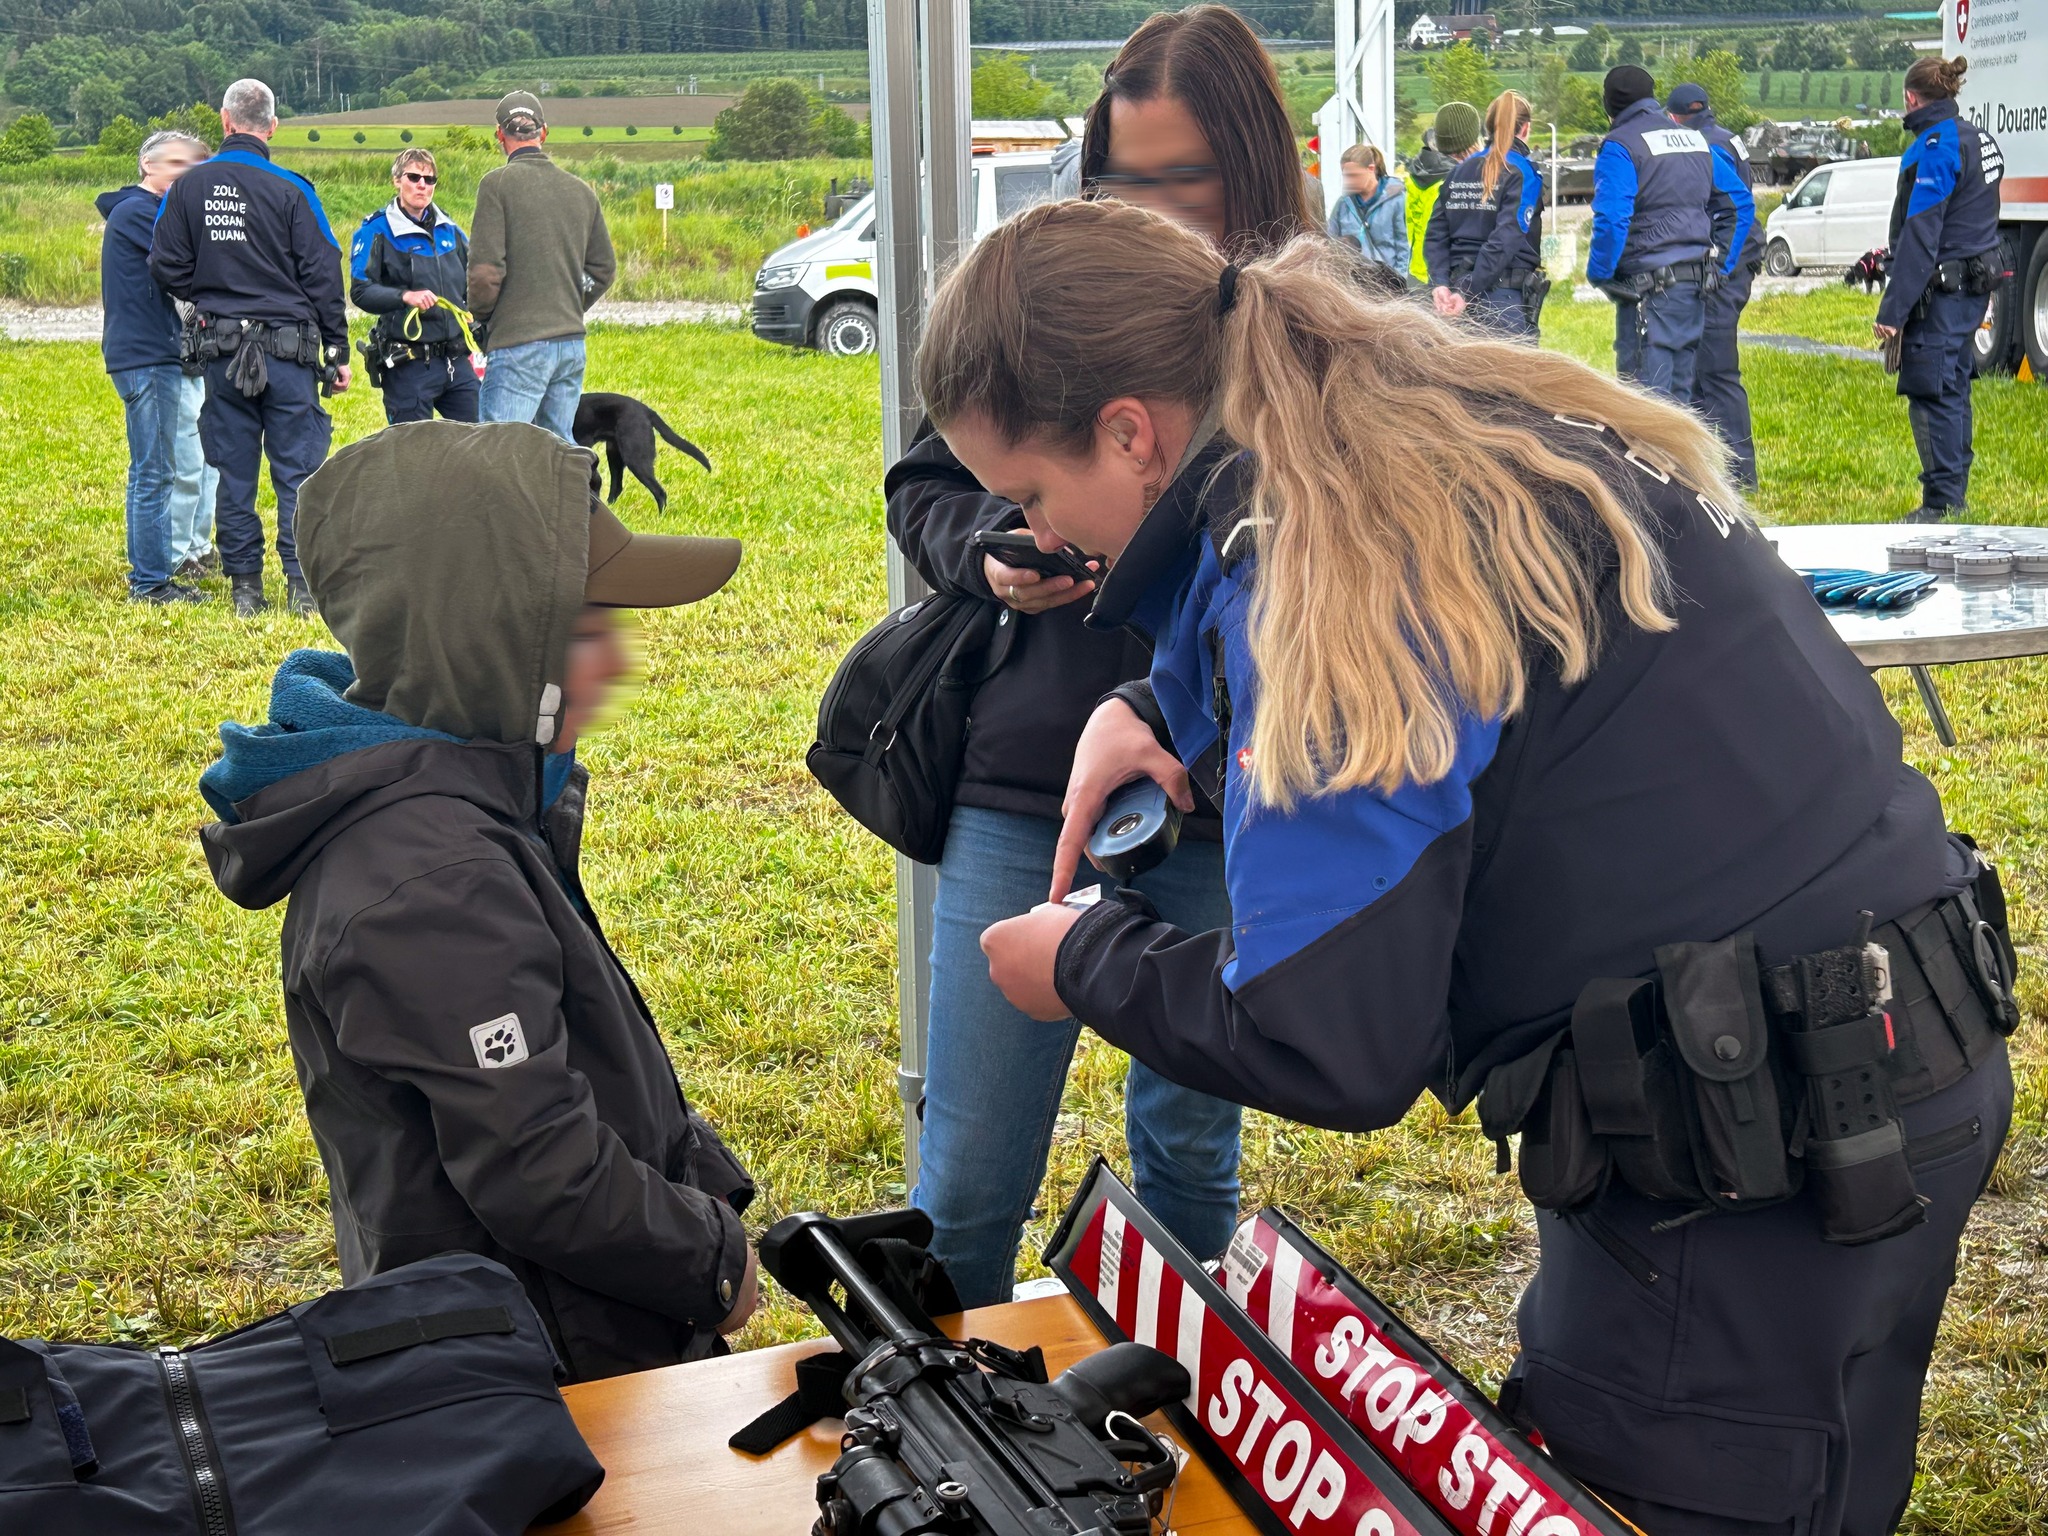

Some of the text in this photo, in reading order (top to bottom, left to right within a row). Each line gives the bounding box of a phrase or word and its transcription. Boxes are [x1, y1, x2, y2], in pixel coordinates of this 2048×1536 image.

[1998, 103, 2047, 134] Douane
[1662, 134, 1696, 148] ZOLL
[213, 185, 239, 198] ZOLL
[211, 230, 248, 242] DUANA
[1315, 1315, 1447, 1454] STOP
[1208, 1358, 1347, 1531] STOP
